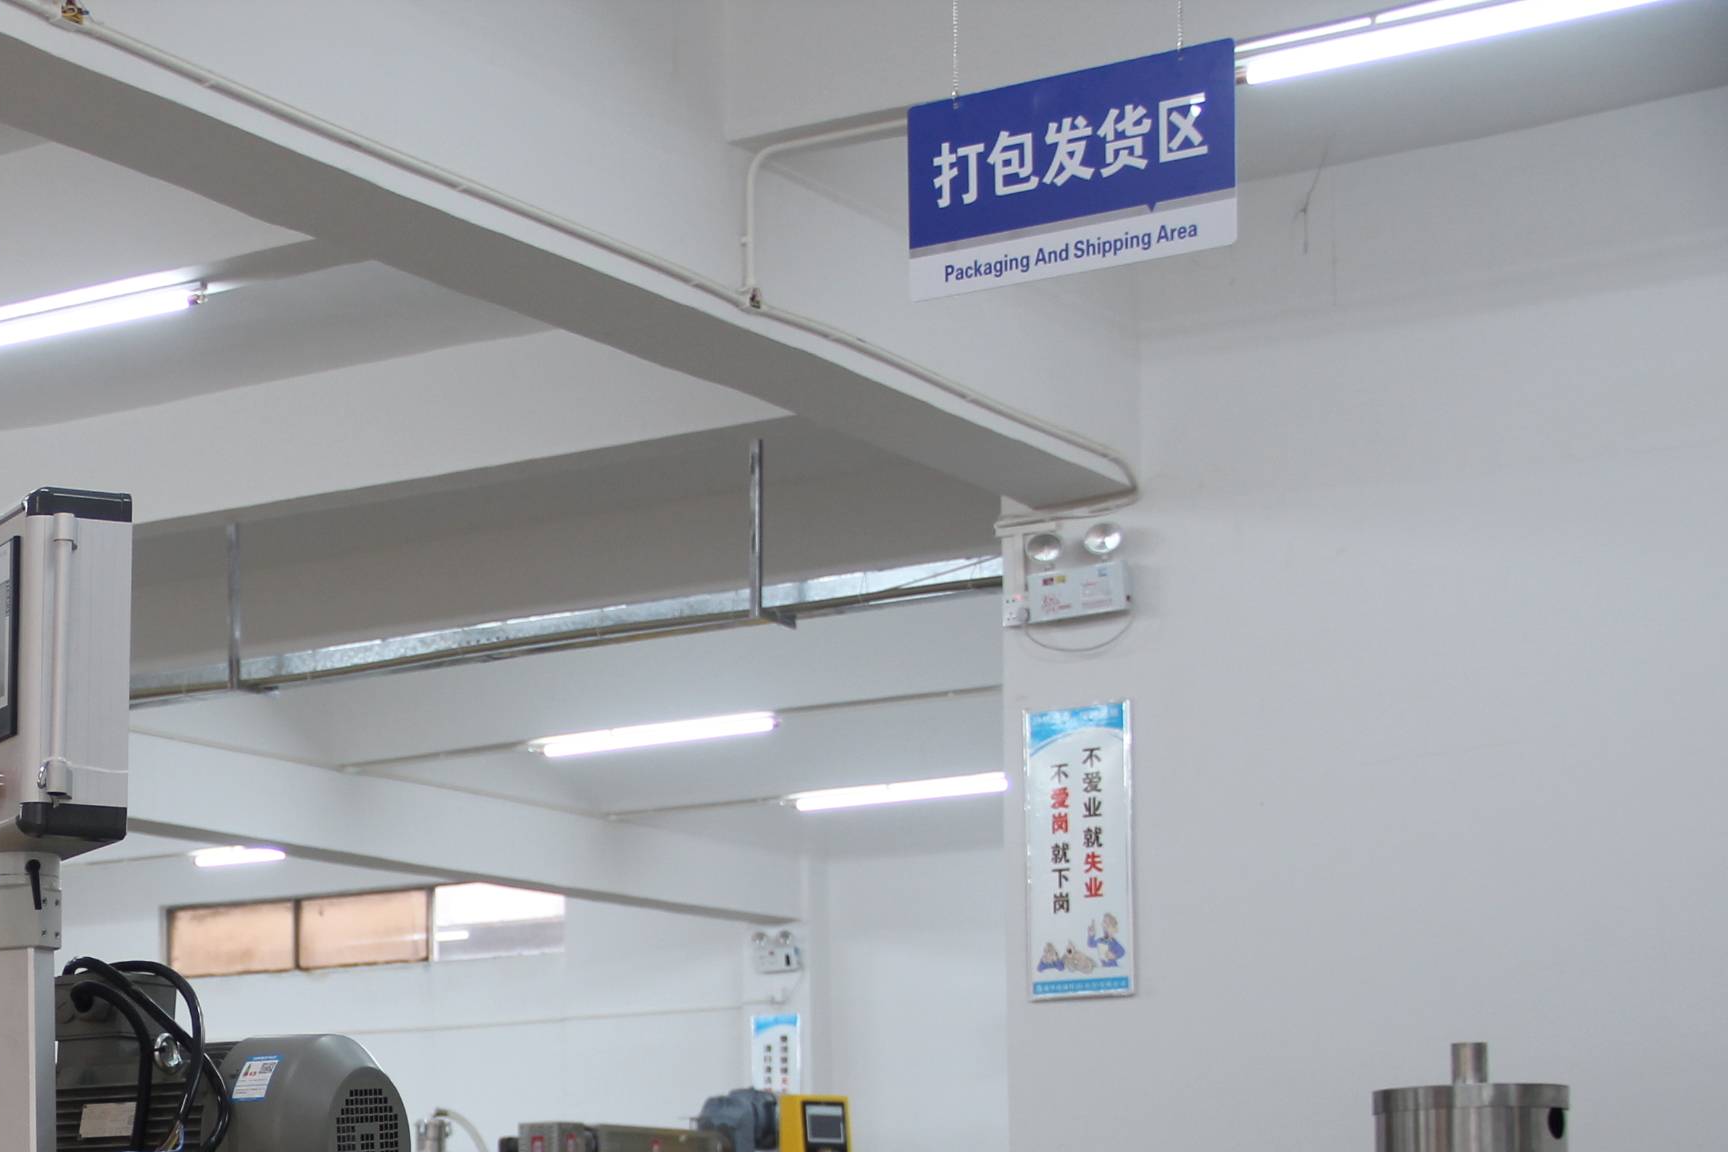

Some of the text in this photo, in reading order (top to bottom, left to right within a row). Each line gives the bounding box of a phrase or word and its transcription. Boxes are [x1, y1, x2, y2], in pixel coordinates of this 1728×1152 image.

[933, 92, 1209, 209] 打包发货区
[944, 224, 1198, 282] Packaging And Shipping Area
[1050, 763, 1071, 914] 不爱岗就下岗
[1082, 747, 1104, 898] 不爱业就失业
